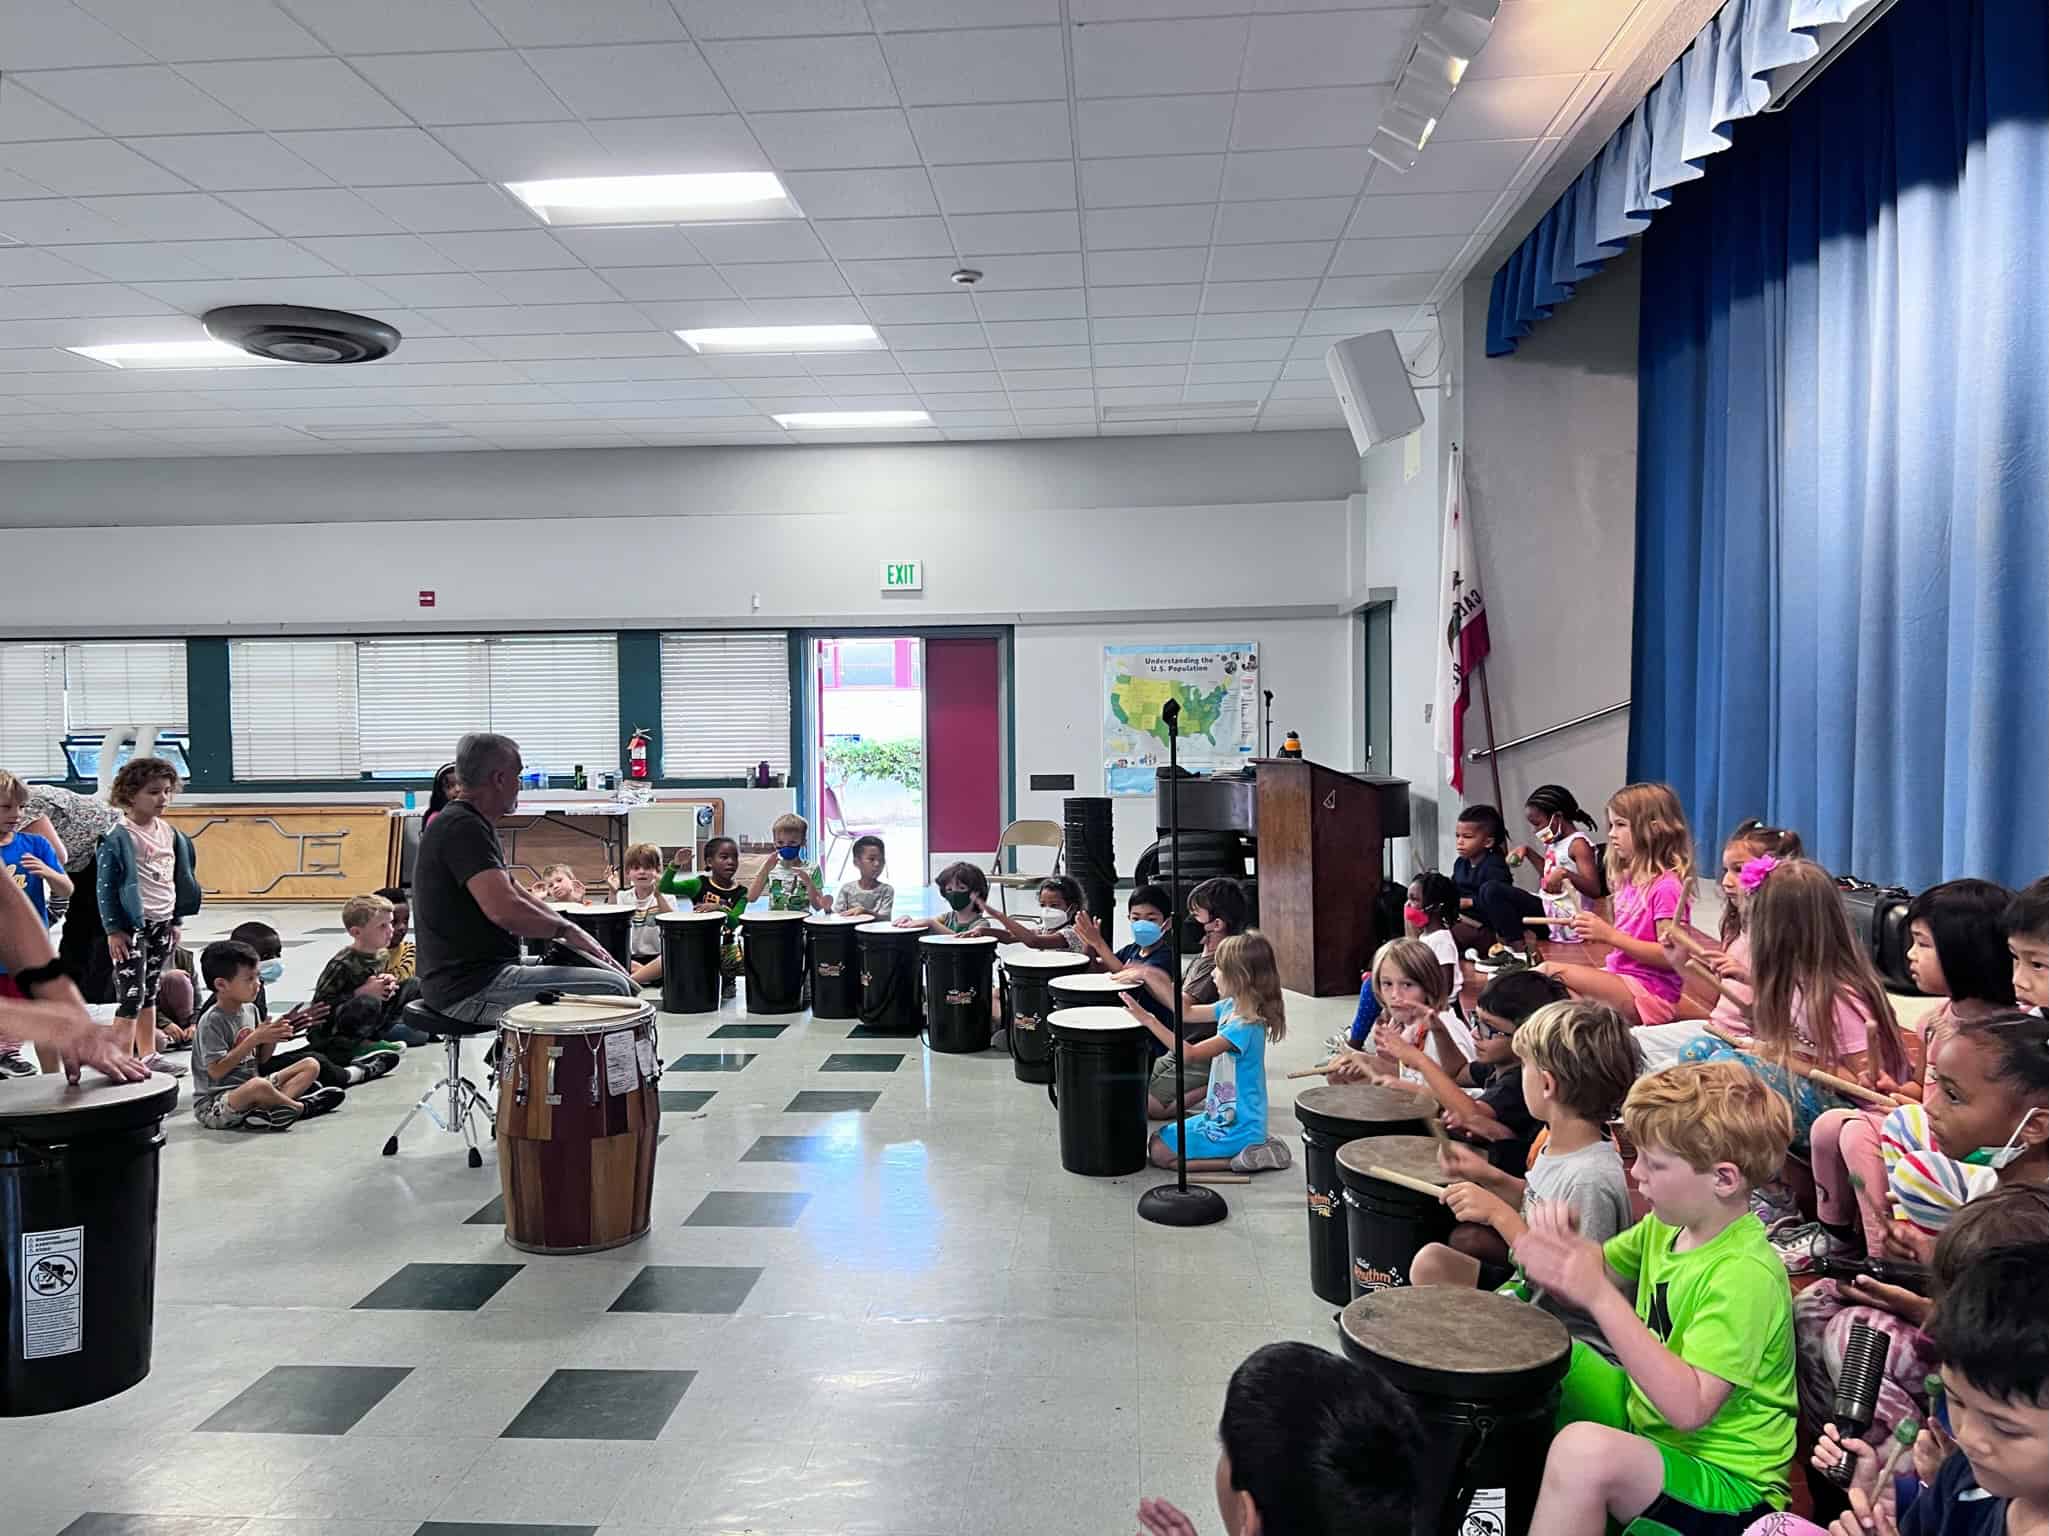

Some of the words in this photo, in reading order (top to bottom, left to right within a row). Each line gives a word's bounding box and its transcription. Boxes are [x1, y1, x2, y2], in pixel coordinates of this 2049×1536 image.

[887, 564, 915, 585] EXIT
[1144, 656, 1200, 665] Understanding
[1200, 655, 1214, 664] the
[1168, 664, 1208, 672] Population
